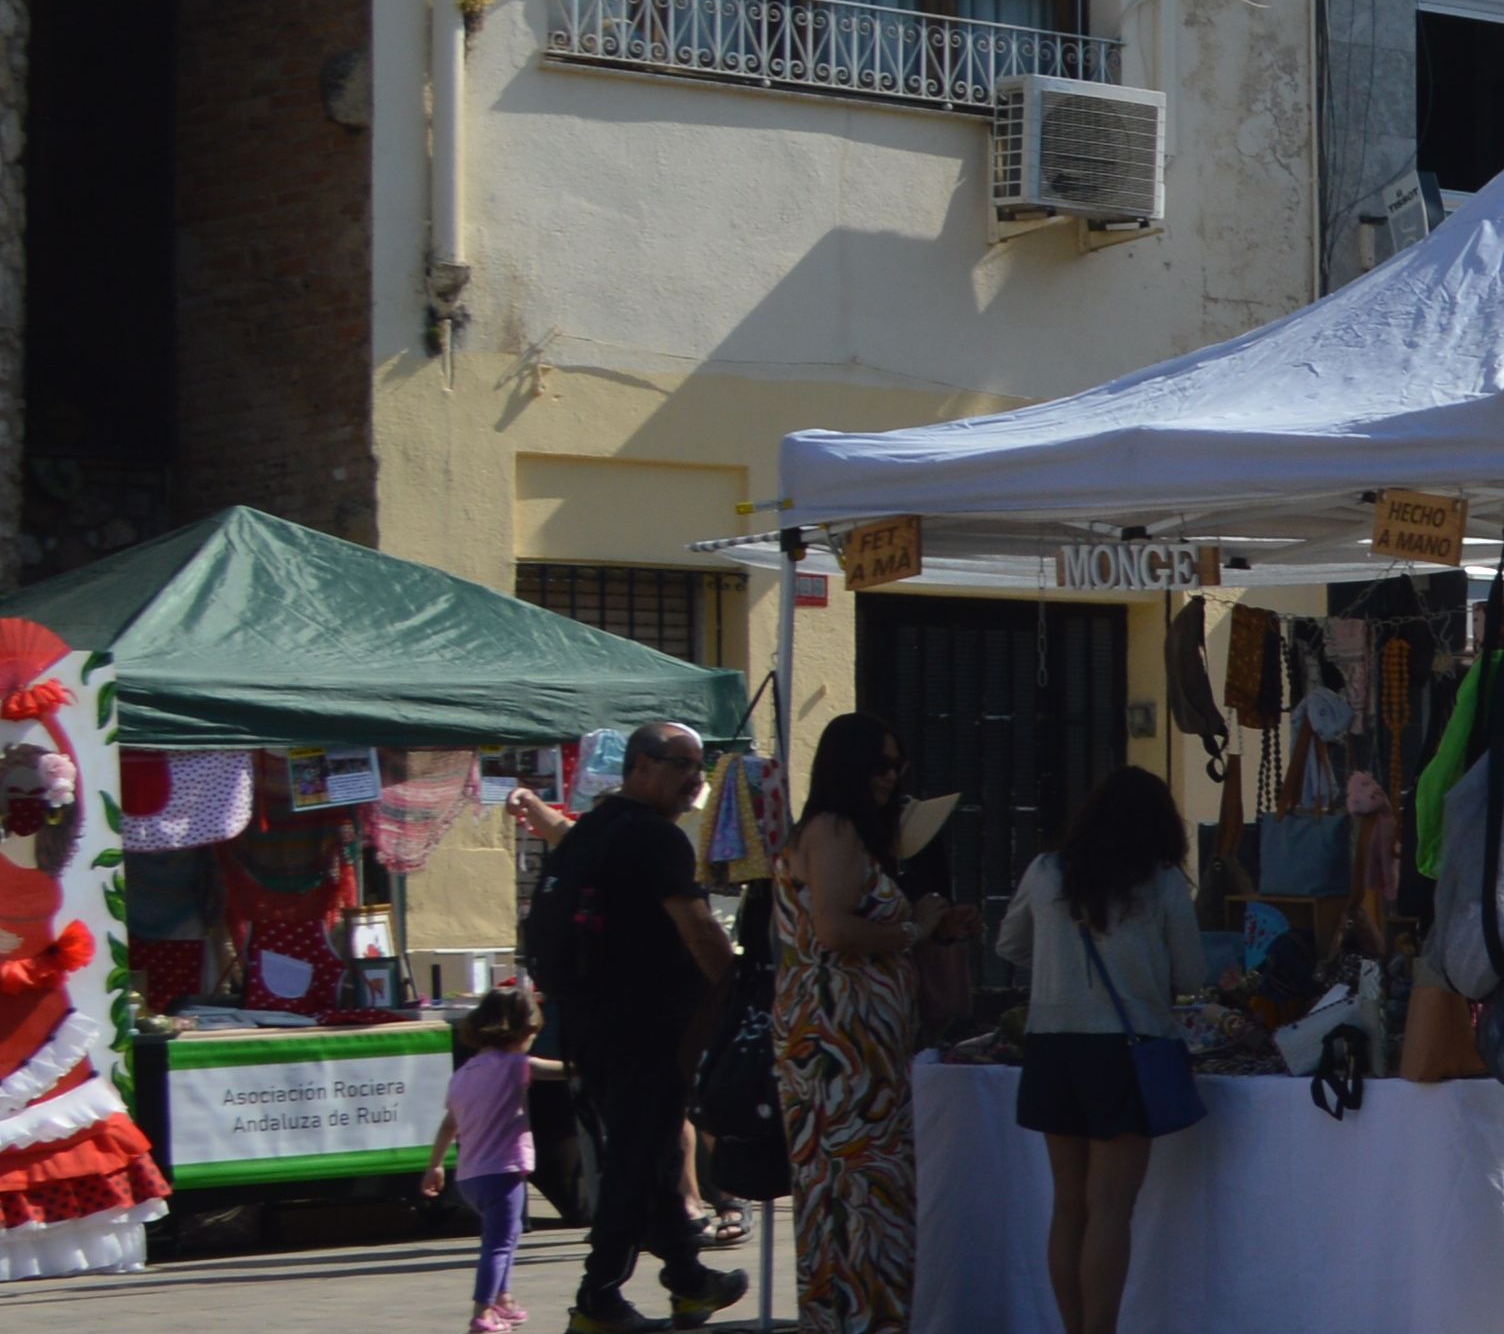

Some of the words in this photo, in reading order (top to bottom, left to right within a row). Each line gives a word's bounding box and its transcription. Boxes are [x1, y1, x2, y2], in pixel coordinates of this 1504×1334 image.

[1388, 501, 1446, 528] HECHO
[861, 526, 898, 552] FET
[1377, 529, 1389, 548] A
[1395, 531, 1451, 558] MANO
[849, 563, 865, 586] A
[1062, 544, 1198, 590] MONGE
[223, 1083, 327, 1106] Asociación
[334, 1078, 406, 1099] Rociera
[233, 1115, 322, 1134] Andaluza
[328, 1110, 350, 1127] de
[357, 1103, 399, 1125] Rubí
